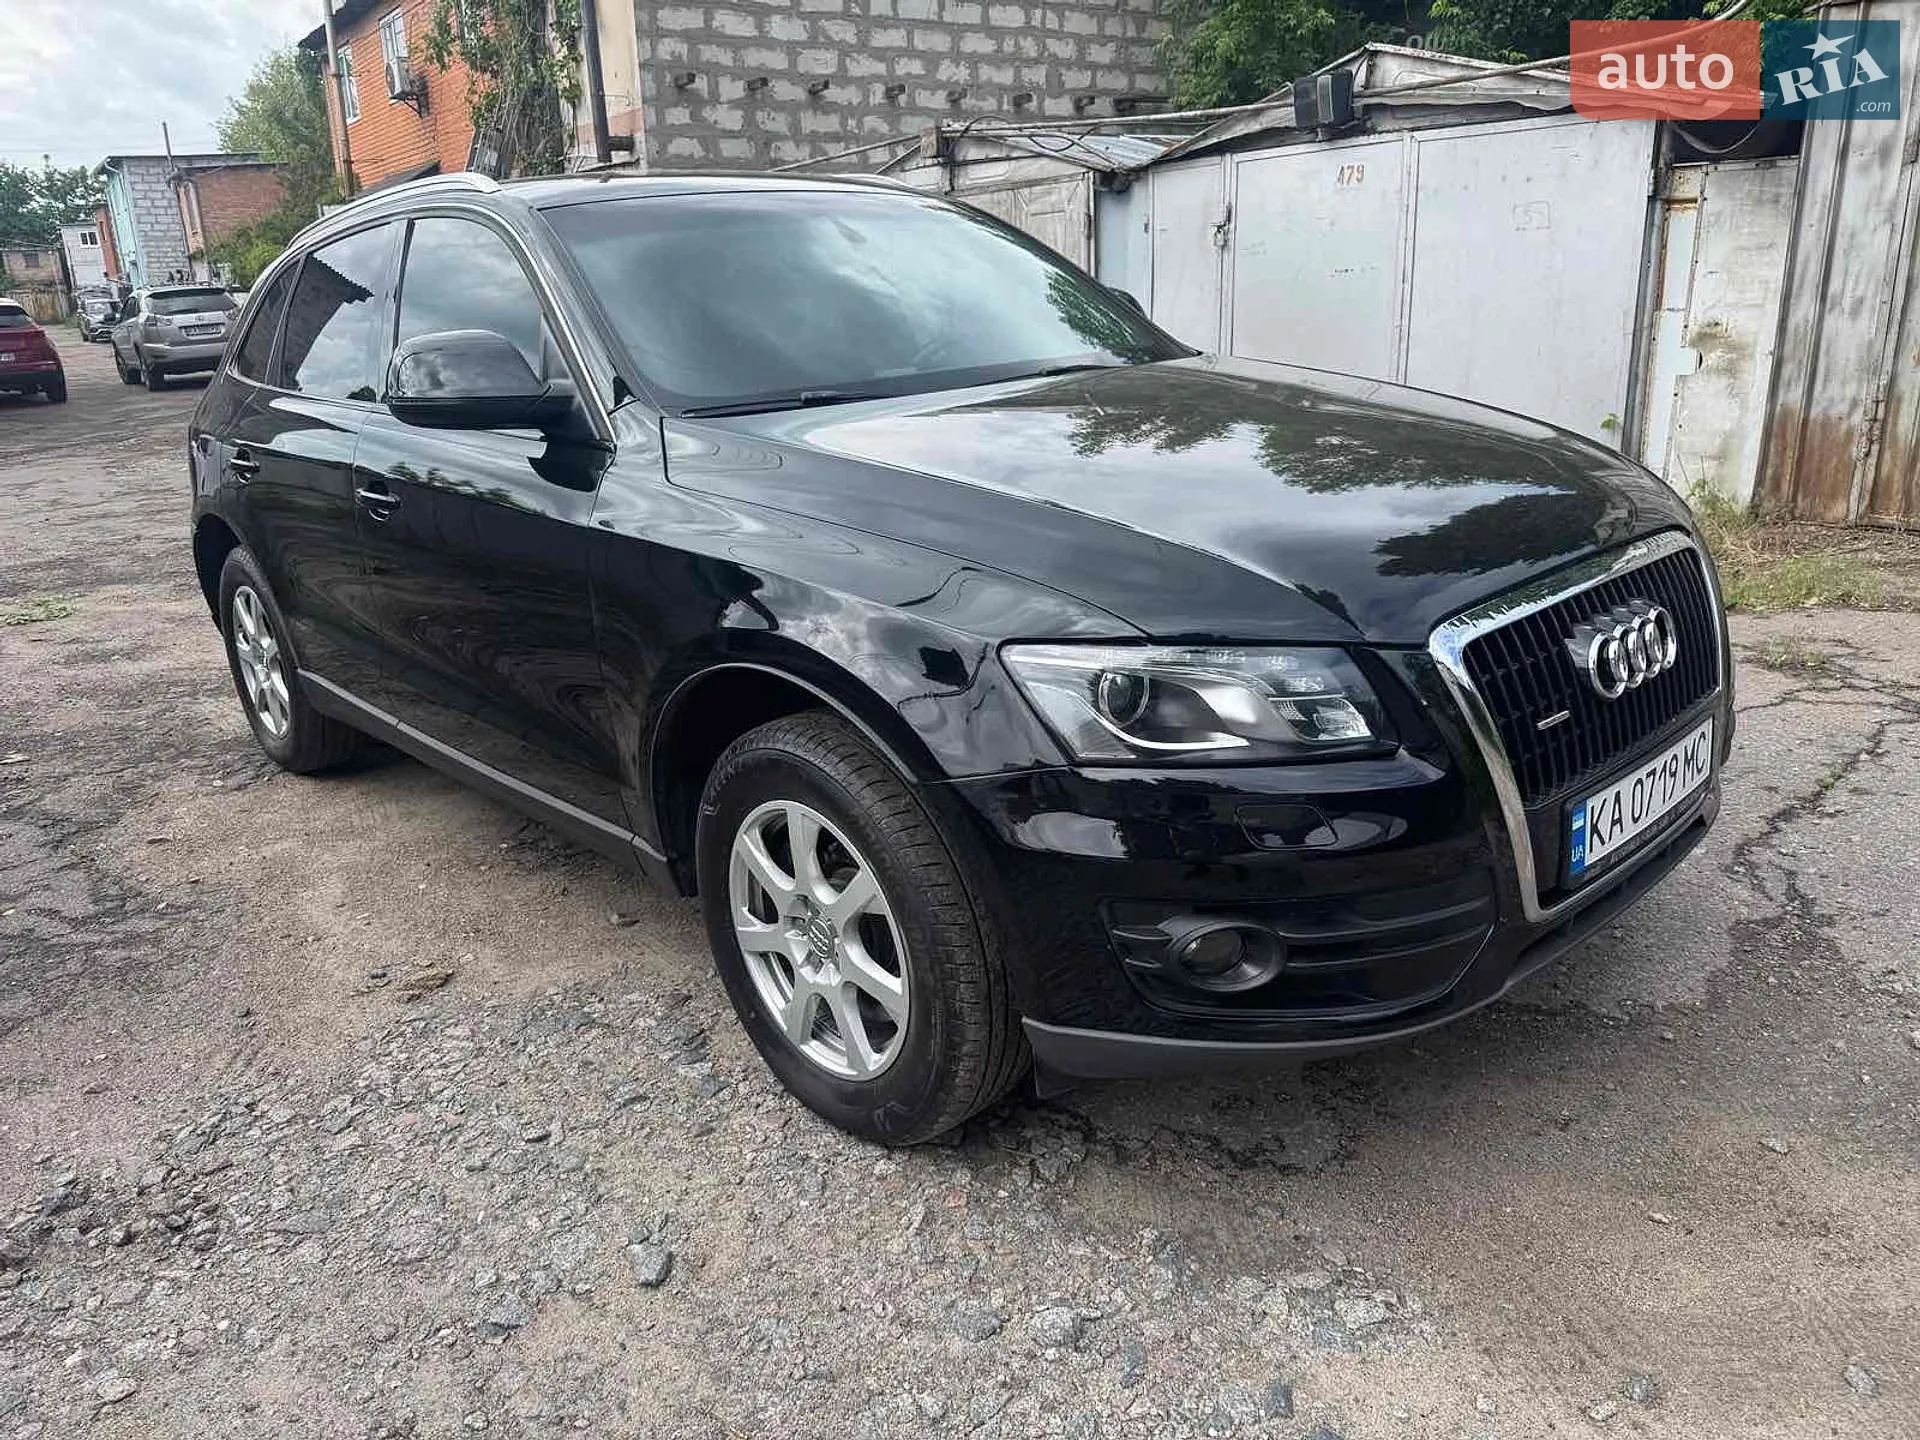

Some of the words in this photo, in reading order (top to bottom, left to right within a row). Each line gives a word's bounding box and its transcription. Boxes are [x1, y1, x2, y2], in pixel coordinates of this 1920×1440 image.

[1588, 791, 1624, 854] KA
[1630, 752, 1679, 825] 0719
[1682, 731, 1707, 788] MC
[1571, 844, 1585, 863] UA
